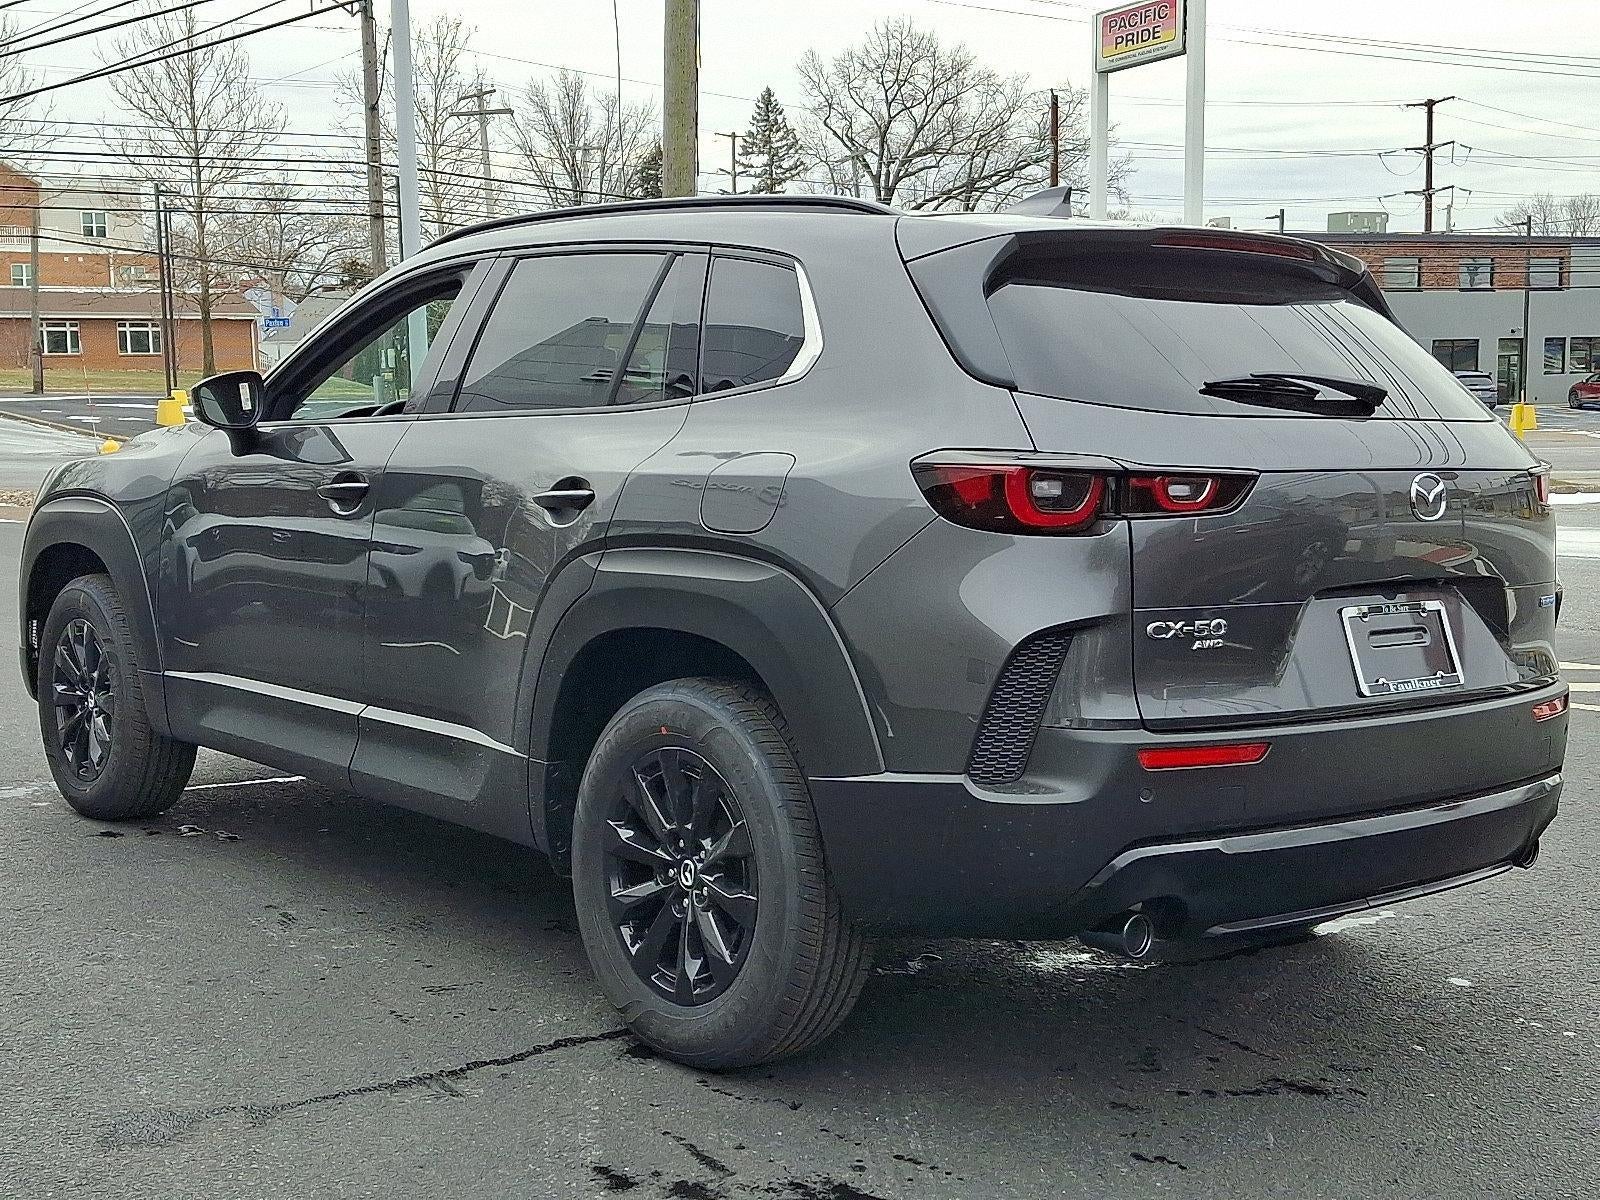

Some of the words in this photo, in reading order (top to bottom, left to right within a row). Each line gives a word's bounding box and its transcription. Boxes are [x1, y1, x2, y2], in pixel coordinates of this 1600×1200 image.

[1108, 4, 1169, 34] PACIFIC
[1114, 25, 1162, 50] PRIDE
[1146, 618, 1228, 639] CX-50
[1190, 639, 1224, 650] AWD
[1389, 679, 1442, 693] Faulkner
